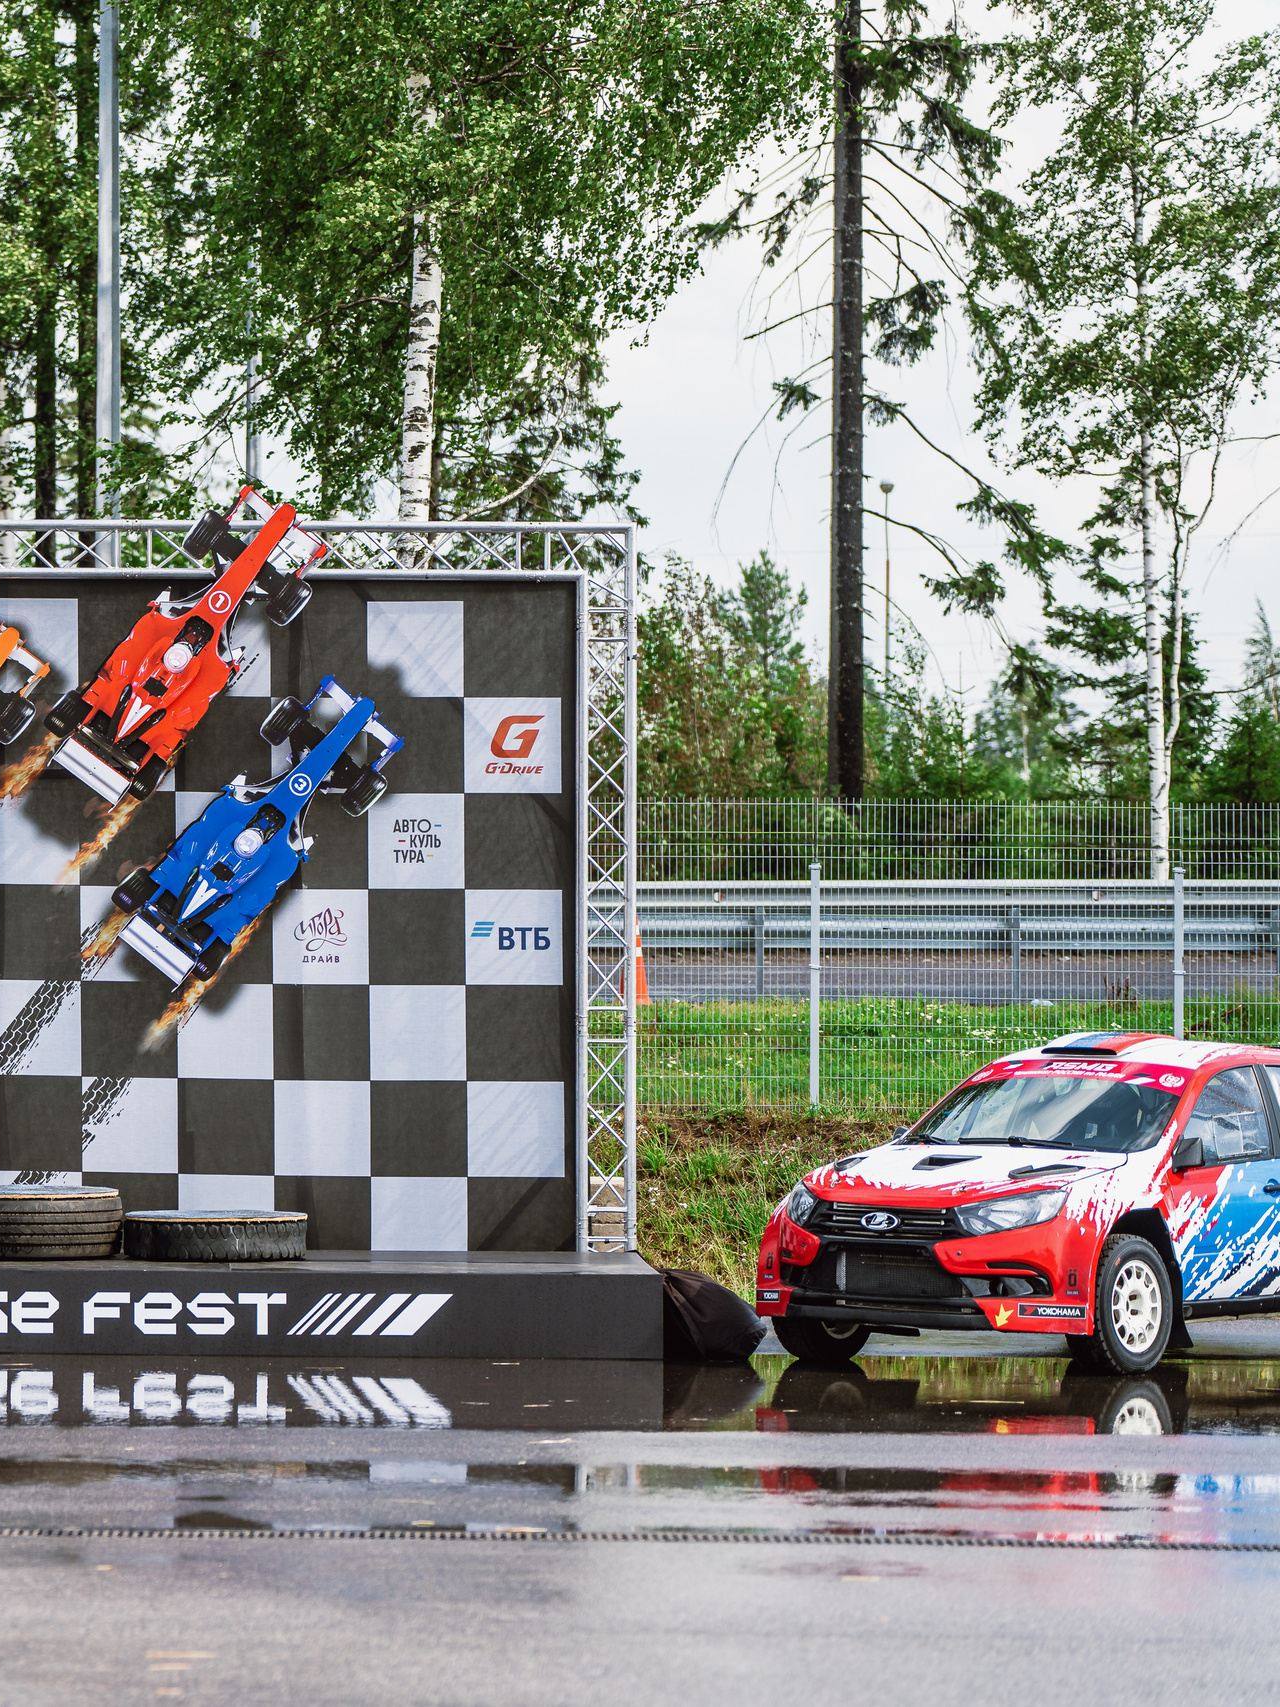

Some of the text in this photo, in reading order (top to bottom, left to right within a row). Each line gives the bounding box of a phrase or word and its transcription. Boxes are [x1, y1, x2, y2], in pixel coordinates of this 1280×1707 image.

[215, 593, 226, 609] 1
[294, 777, 308, 791] 3
[497, 926, 551, 951] ВТБ
[301, 953, 341, 964] ДРАЙВ
[1043, 1061, 1119, 1072] ASMG
[1037, 1306, 1081, 1317] YOKOHAMA
